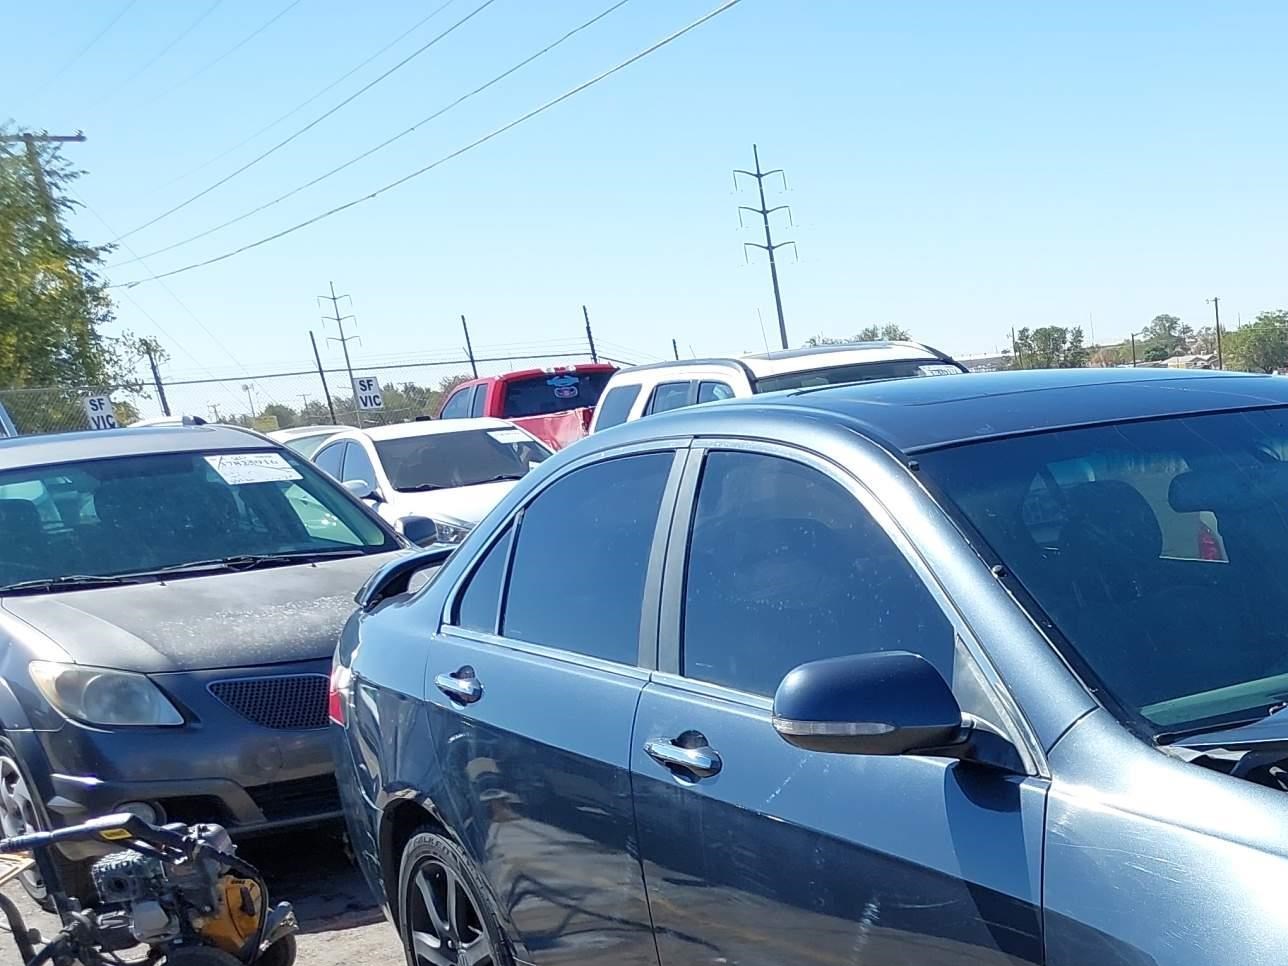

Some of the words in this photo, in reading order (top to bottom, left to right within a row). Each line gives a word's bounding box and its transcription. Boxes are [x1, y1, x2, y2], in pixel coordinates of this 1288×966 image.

[359, 379, 373, 391] SF
[89, 398, 105, 411] SF
[359, 394, 382, 407] VIC
[91, 414, 115, 430] VIC
